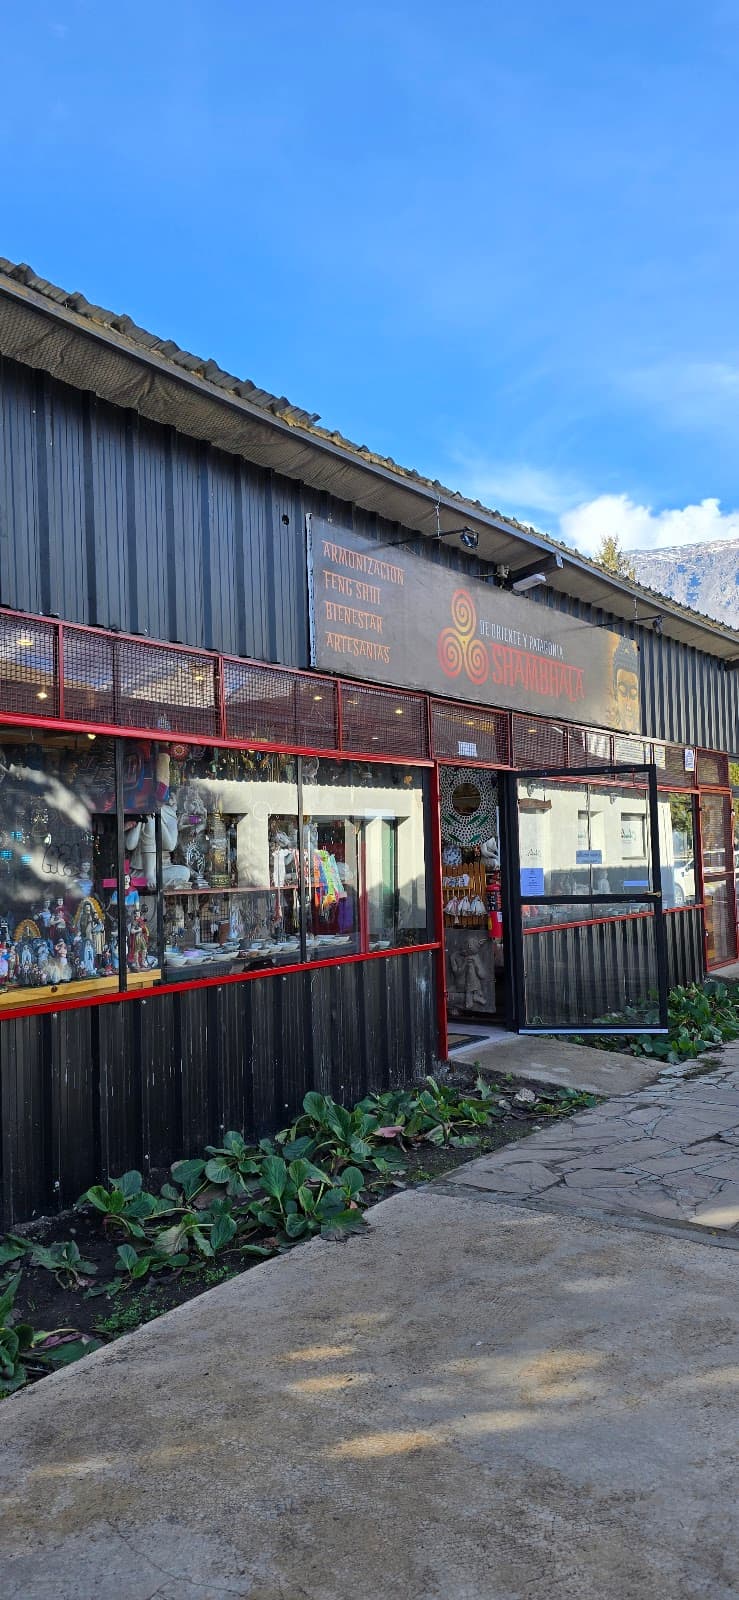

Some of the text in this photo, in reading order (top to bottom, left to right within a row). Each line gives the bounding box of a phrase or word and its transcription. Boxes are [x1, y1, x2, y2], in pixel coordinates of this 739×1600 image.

[322, 540, 405, 585] ARMONIZACION
[323, 570, 353, 596] FENG
[324, 600, 383, 634] BIENESTAR
[326, 631, 391, 664] ARTESANIAS
[479, 619, 564, 660] DE ORIENTE Y PATAGONIA
[489, 642, 586, 702] SHAMBHALA
